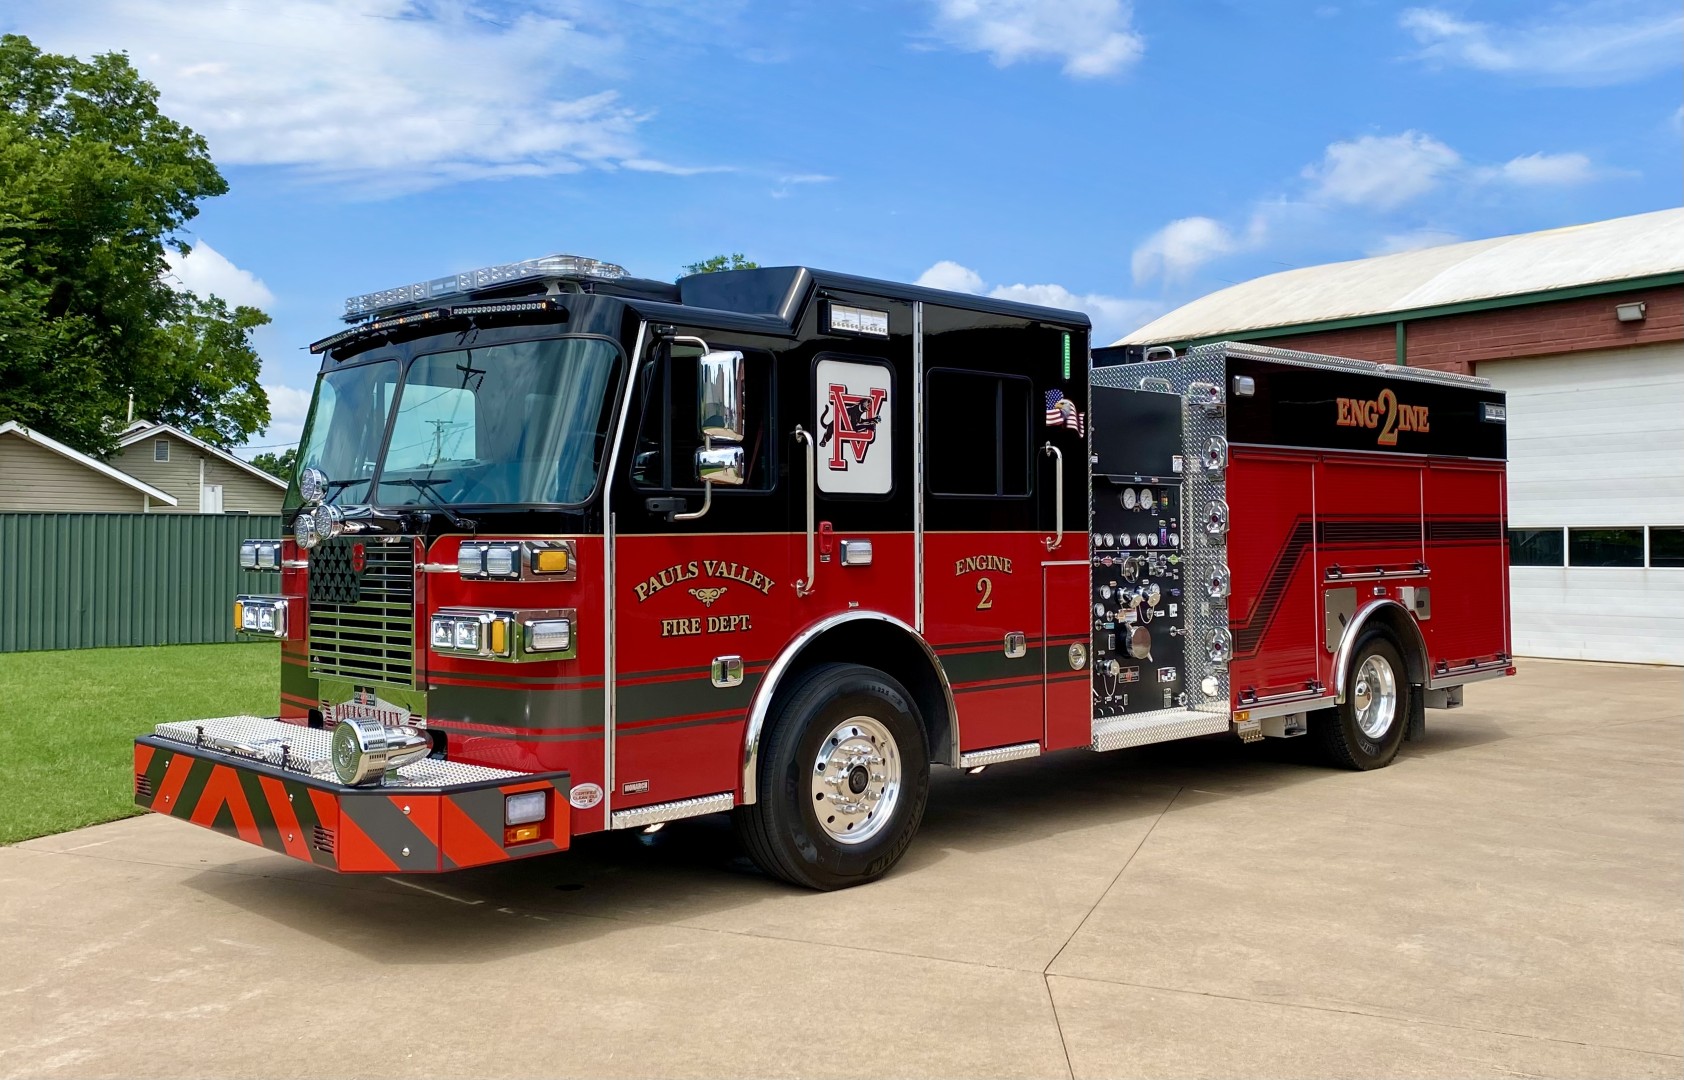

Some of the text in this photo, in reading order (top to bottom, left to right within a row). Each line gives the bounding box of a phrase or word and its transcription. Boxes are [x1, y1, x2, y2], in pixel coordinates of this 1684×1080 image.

[955, 554, 1013, 576] ENGINE
[633, 559, 775, 602] PAULS VALLEY
[976, 577, 992, 610] 2
[661, 614, 752, 637] FIRE DEPT.
